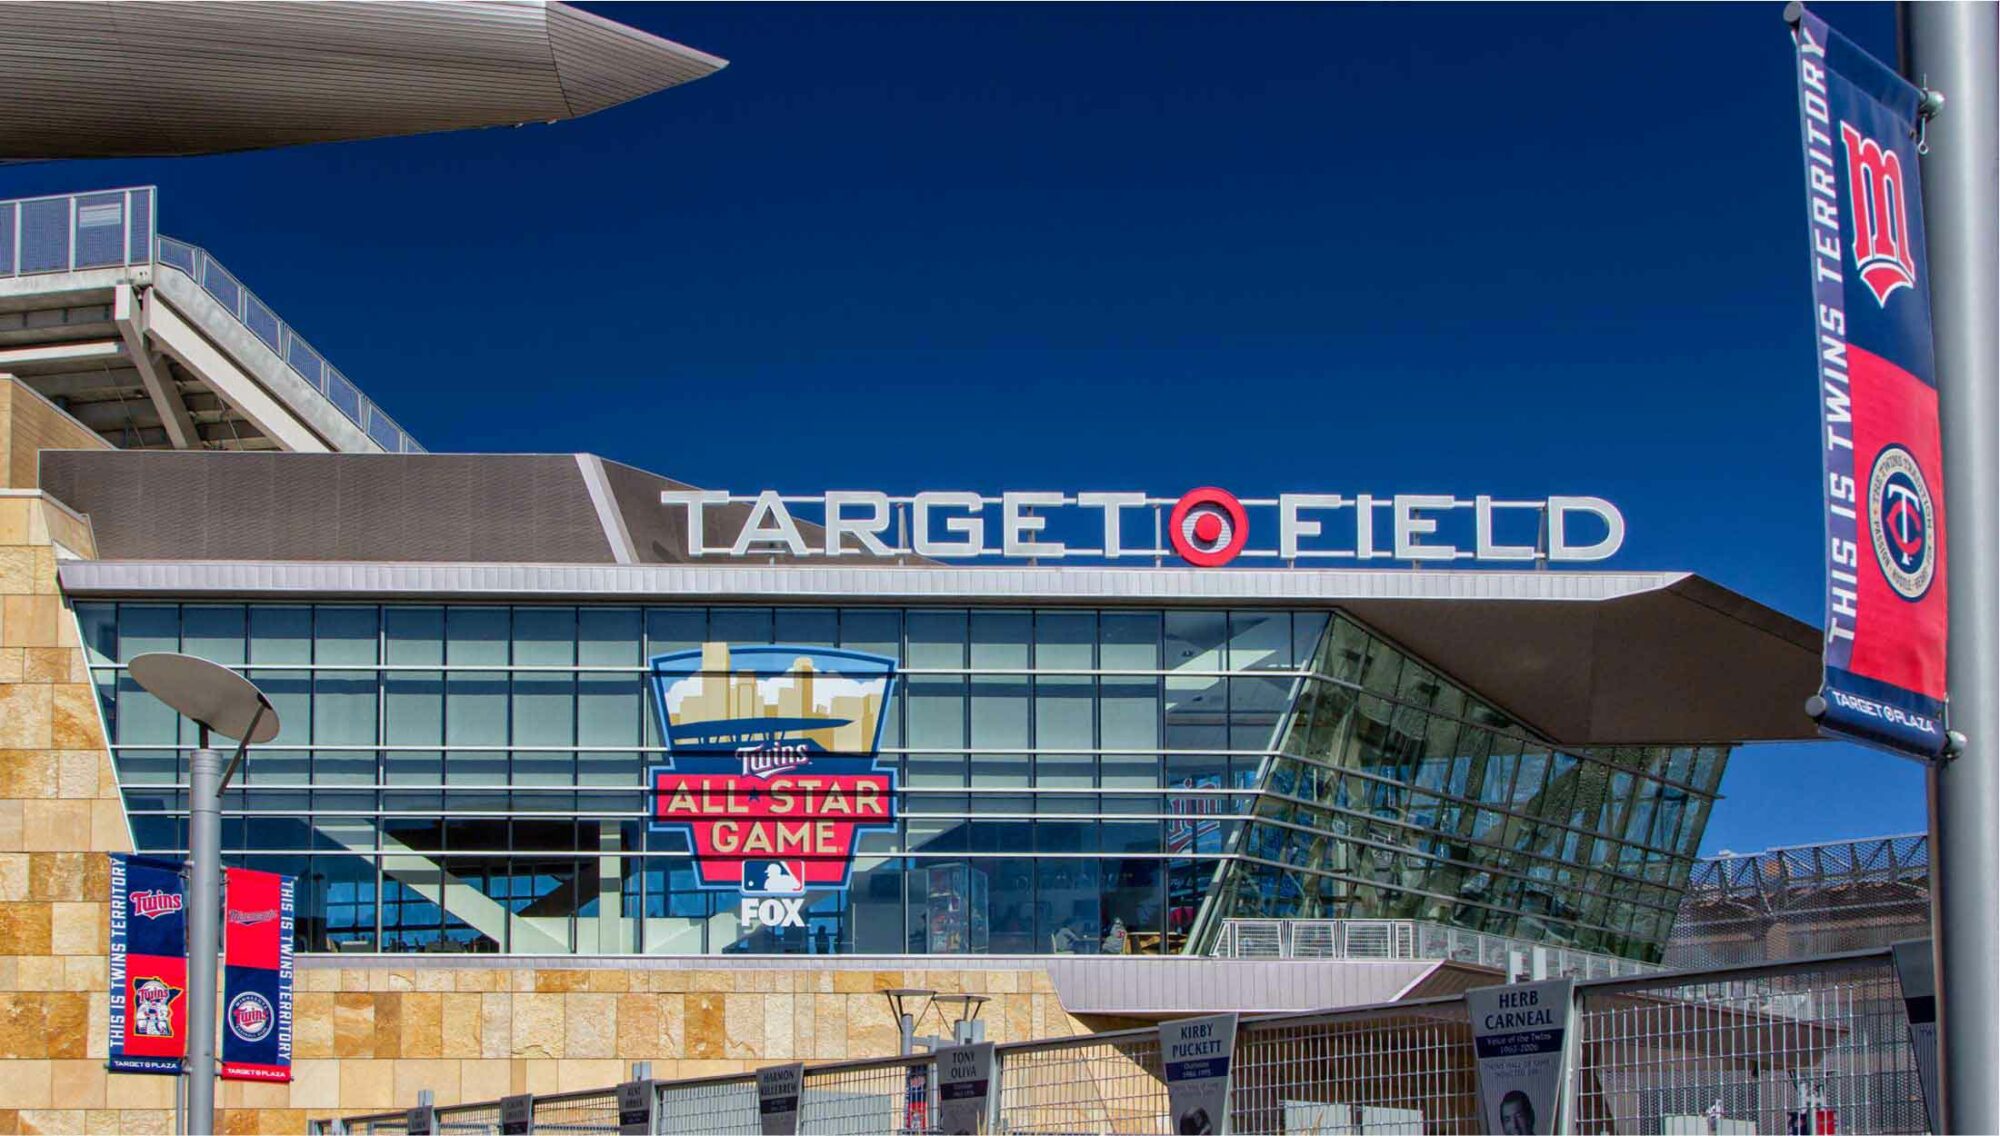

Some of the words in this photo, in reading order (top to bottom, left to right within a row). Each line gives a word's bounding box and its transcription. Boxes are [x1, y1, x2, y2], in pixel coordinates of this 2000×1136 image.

[1799, 27, 1844, 284] TERRITORY
[1820, 305, 1854, 450] TWINS
[1829, 470, 1857, 520] IS
[660, 489, 1147, 559] TARGET
[1278, 493, 1625, 561] FIELD
[1828, 535, 1857, 643] THIS
[1831, 689, 1885, 720] TARGET
[1894, 708, 1936, 735] PLAZA
[735, 741, 811, 779] Twins
[667, 778, 750, 814] ALL
[768, 778, 884, 815] STAR
[711, 819, 840, 853] GAME
[111, 856, 127, 937] TERRITORY
[129, 889, 183, 920] Twins
[281, 881, 294, 911] THIS
[281, 916, 294, 929] IS
[740, 897, 806, 928] FOX
[111, 942, 126, 989] TWINS
[279, 935, 294, 979] TWINS
[111, 995, 126, 1009] IS
[137, 986, 169, 1003] Twins
[1498, 990, 1539, 1009] HERB
[110, 1015, 125, 1047] THIS
[232, 1007, 268, 1028] Twins
[277, 982, 293, 1061] TERRITORY
[1181, 1023, 1213, 1040] KIRBY
[1484, 1008, 1554, 1030] CARNEAL
[1172, 1040, 1221, 1058] PUCKETT
[1531, 1032, 1552, 1041] Twins
[114, 1060, 145, 1069] TARGET
[151, 1061, 178, 1070] PLAZA
[227, 1067, 257, 1076] TARGET
[261, 1069, 286, 1078] PLAZA
[950, 1066, 977, 1079] OLIVA
[952, 1051, 975, 1064] TONY
